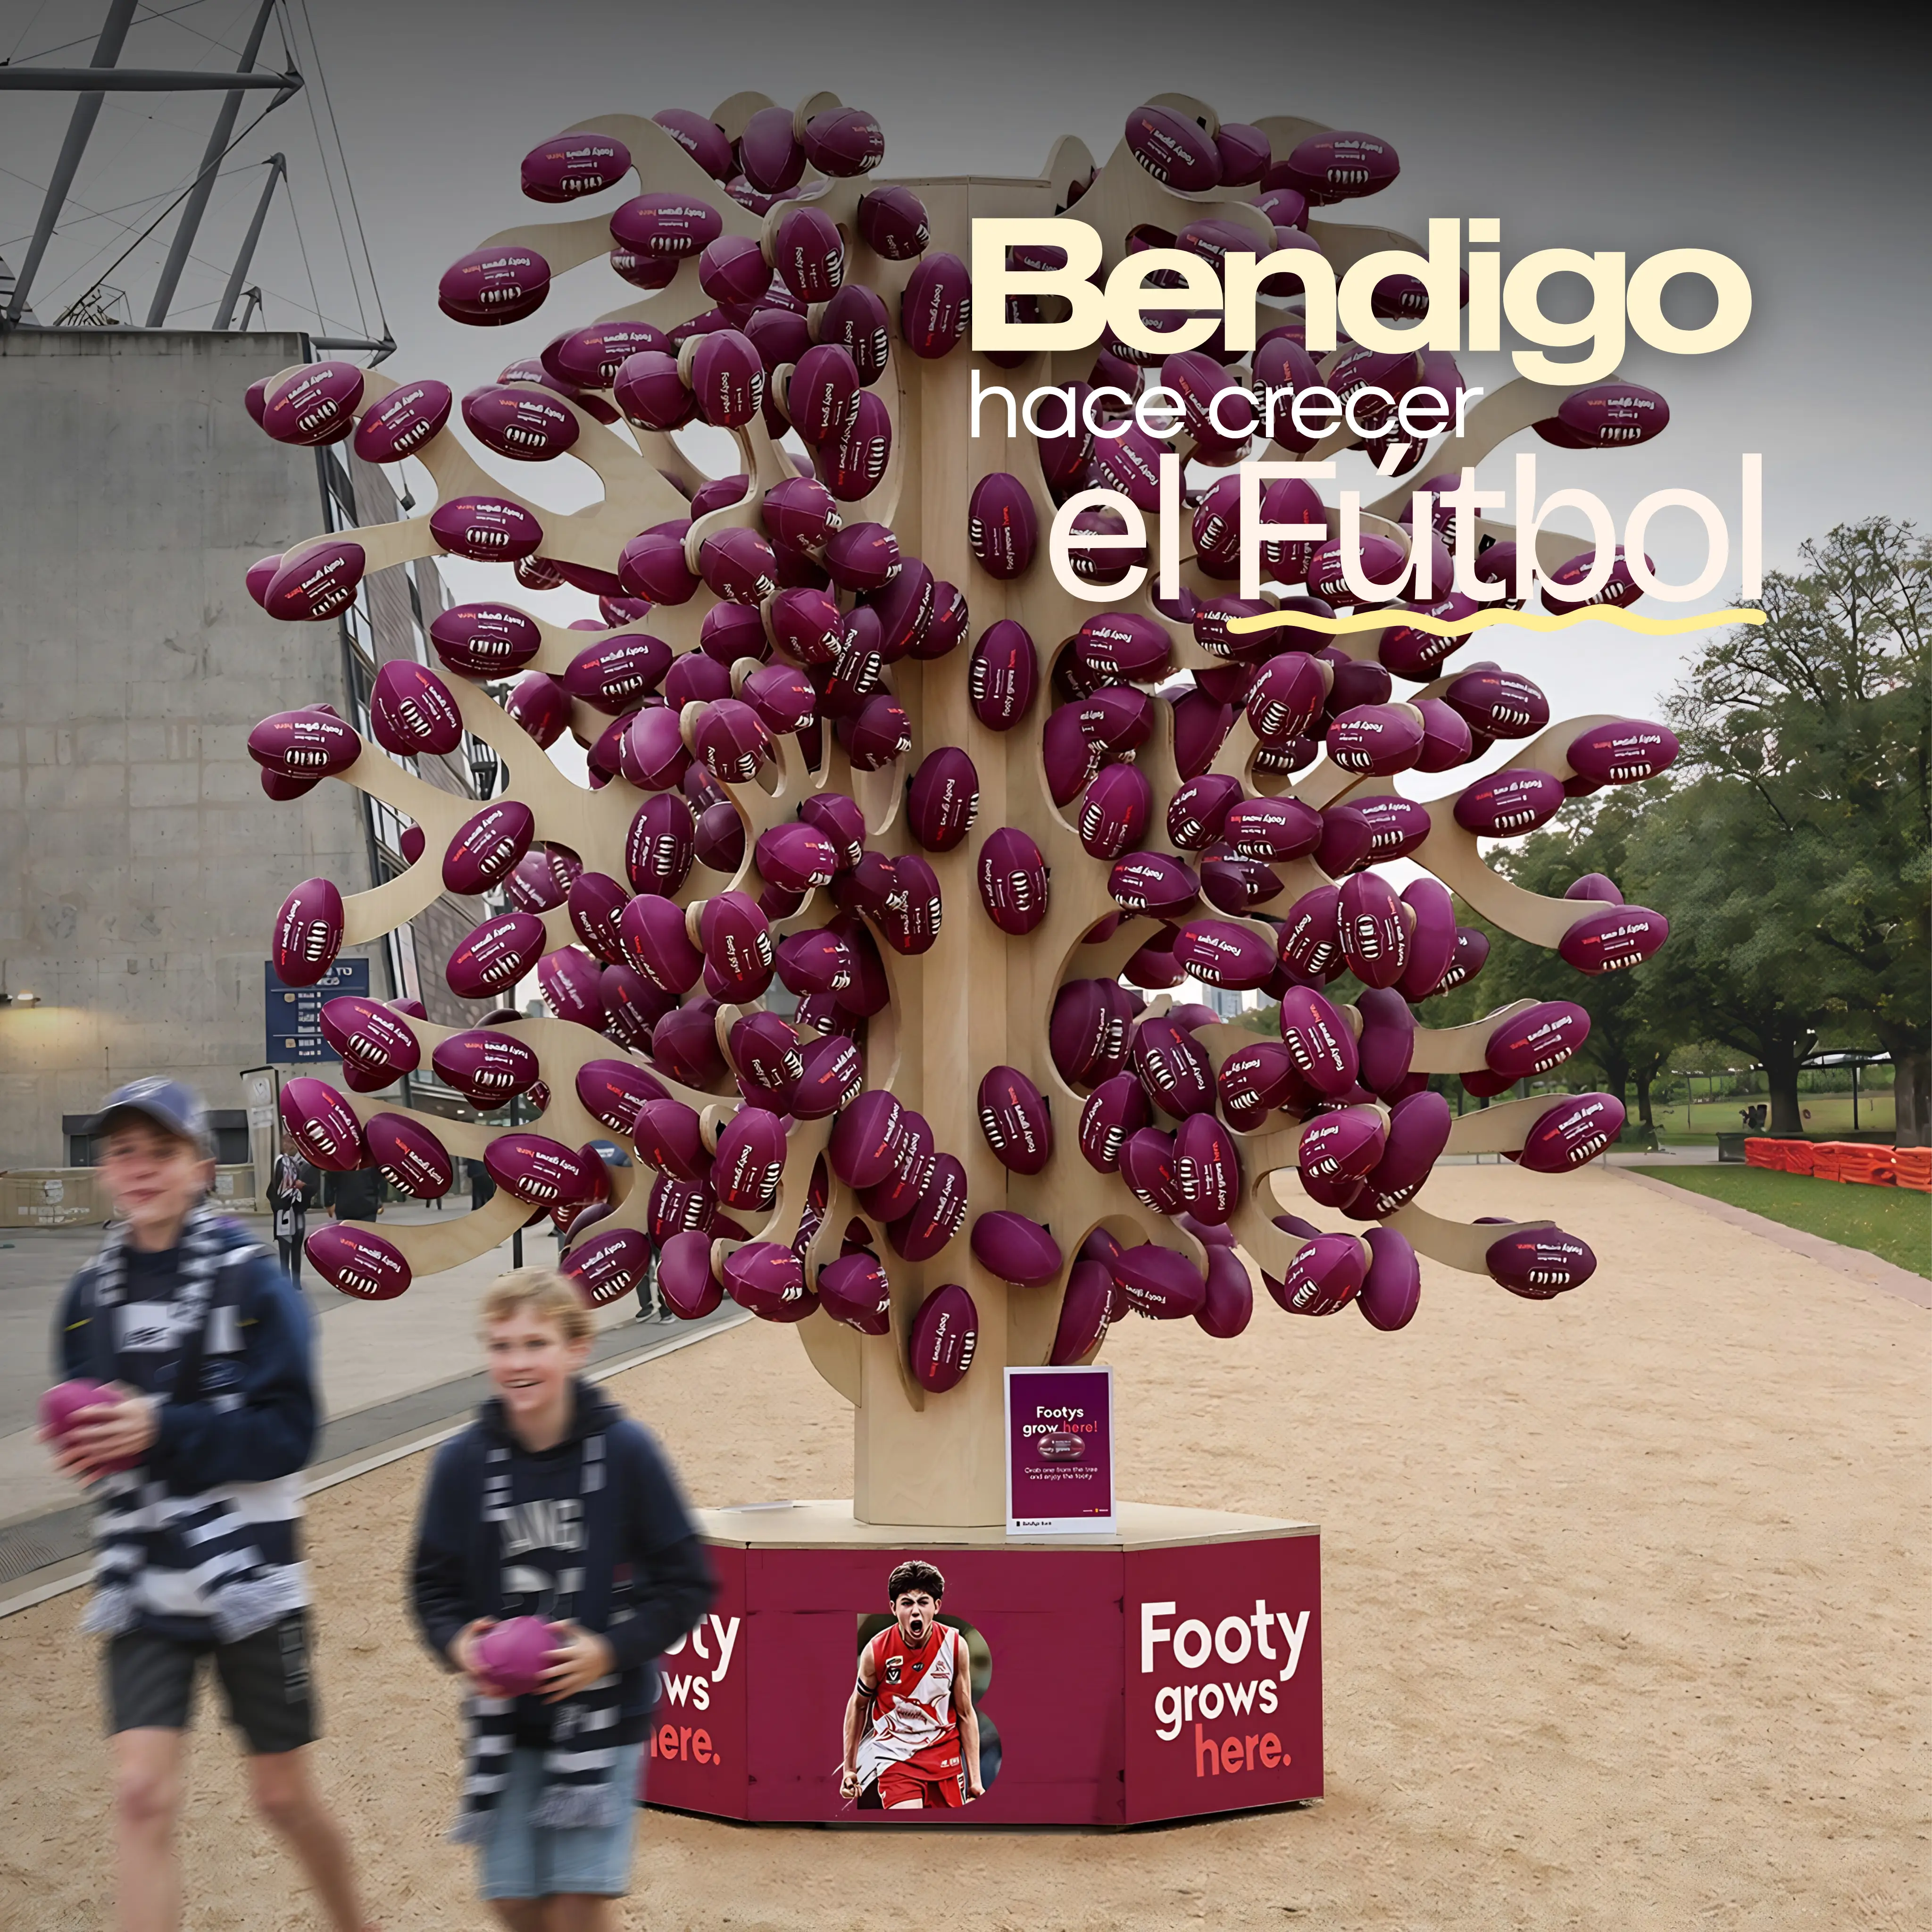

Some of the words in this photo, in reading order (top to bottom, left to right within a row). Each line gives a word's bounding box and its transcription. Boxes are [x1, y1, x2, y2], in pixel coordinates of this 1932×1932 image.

[1023, 1424, 1058, 1437] grow
[1063, 1420, 1098, 1433] here!
[1036, 1406, 1084, 1422] Footys
[1141, 1599, 1310, 1682] Footy
[1155, 1679, 1278, 1741] grows
[1195, 1723, 1291, 1777] here.
